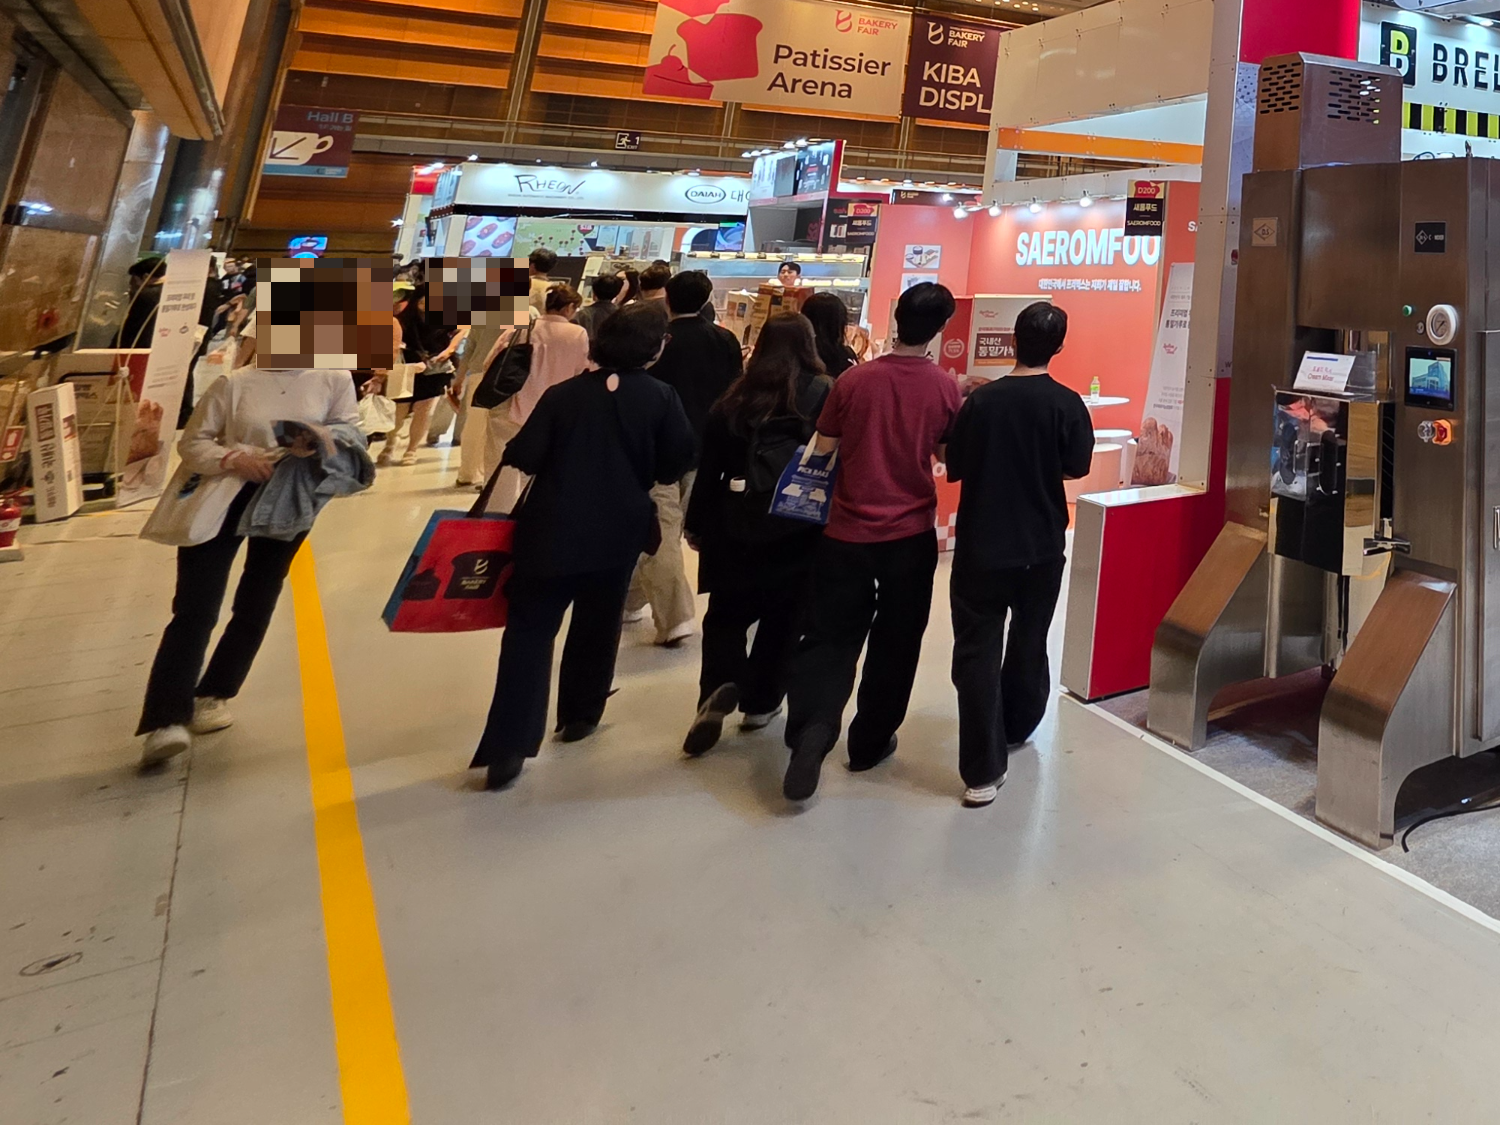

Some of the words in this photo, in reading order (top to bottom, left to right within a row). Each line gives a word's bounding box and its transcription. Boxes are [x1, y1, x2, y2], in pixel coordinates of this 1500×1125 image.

[858, 18, 898, 30] BAKERY
[857, 26, 880, 36] FAIR
[949, 30, 985, 42] BAKERY
[948, 38, 968, 48] FAIR
[773, 44, 891, 76] Patissier
[922, 61, 981, 87] KIBA
[767, 72, 853, 99] Arena
[919, 86, 992, 114] DISPL
[307, 111, 338, 122] Hall
[342, 113, 354, 124] B
[635, 136, 640, 145] 1
[514, 174, 586, 194] RHEON
[731, 189, 750, 203] 대
[1016, 228, 1161, 266] SAEROMFOO
[979, 337, 1002, 345] 국내산
